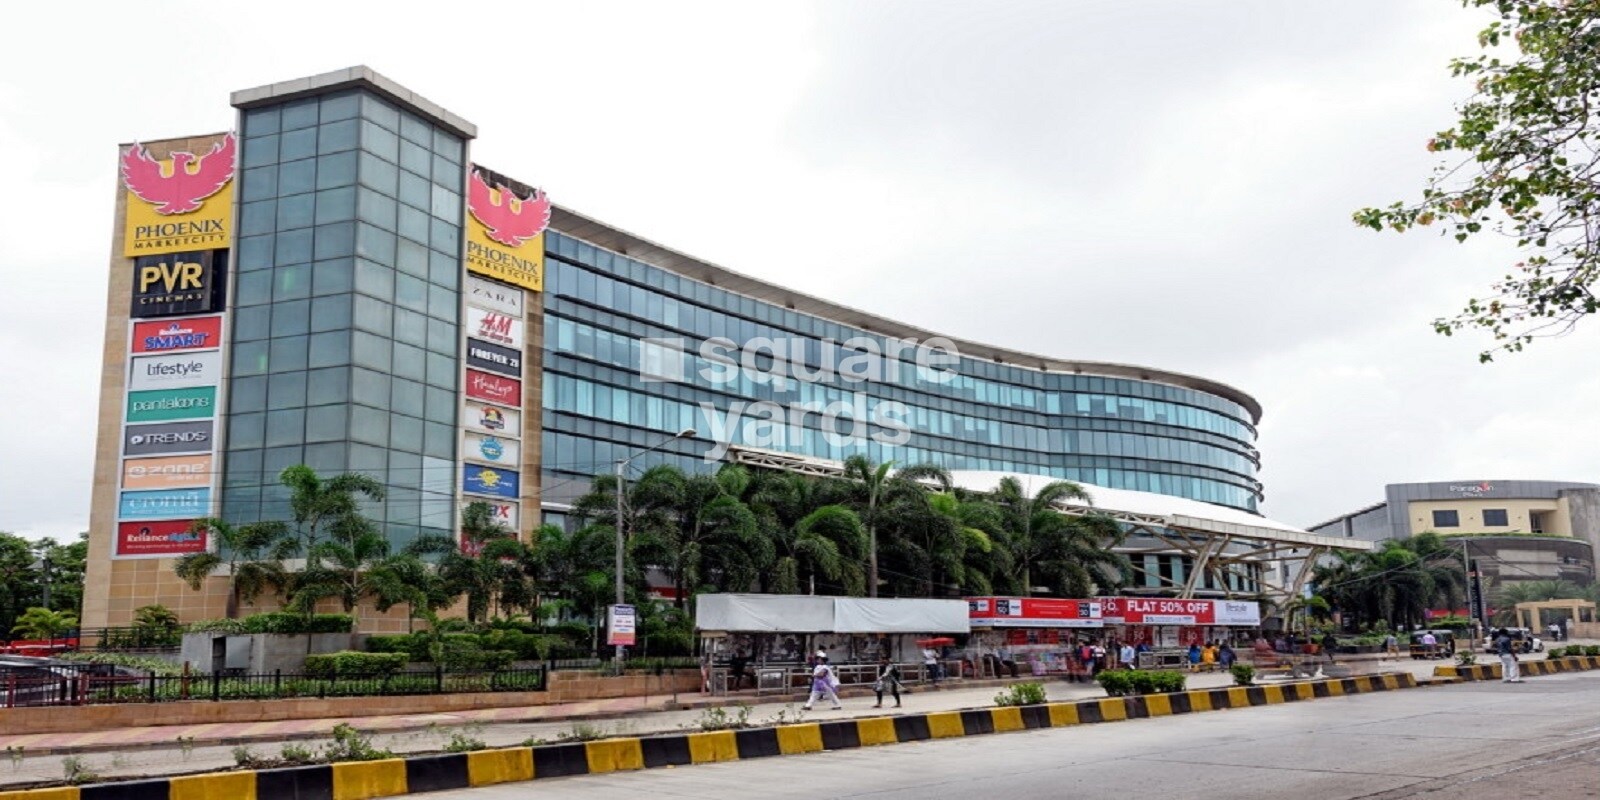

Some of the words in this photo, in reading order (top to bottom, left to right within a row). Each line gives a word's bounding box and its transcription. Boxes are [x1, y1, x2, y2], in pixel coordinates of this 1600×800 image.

[135, 219, 224, 239] PHOENIX
[134, 235, 225, 249] MARKETCITY
[467, 241, 538, 275] PHOENIX
[140, 261, 203, 294] PVR
[467, 258, 540, 284] MARKETCITY
[140, 294, 203, 305] CINEMAS
[473, 287, 516, 306] ZARA
[481, 312, 513, 336] H&M
[144, 332, 209, 350] SMART
[471, 347, 508, 365] FOREVER
[147, 360, 203, 376] lifestyle
[132, 397, 209, 413] pantaloons
[143, 431, 208, 444] TRENDS
[127, 532, 169, 542] Reliance
[1127, 600, 1157, 612] FLAT
[1160, 601, 1184, 613] 50%
[1187, 602, 1209, 613] OFF
